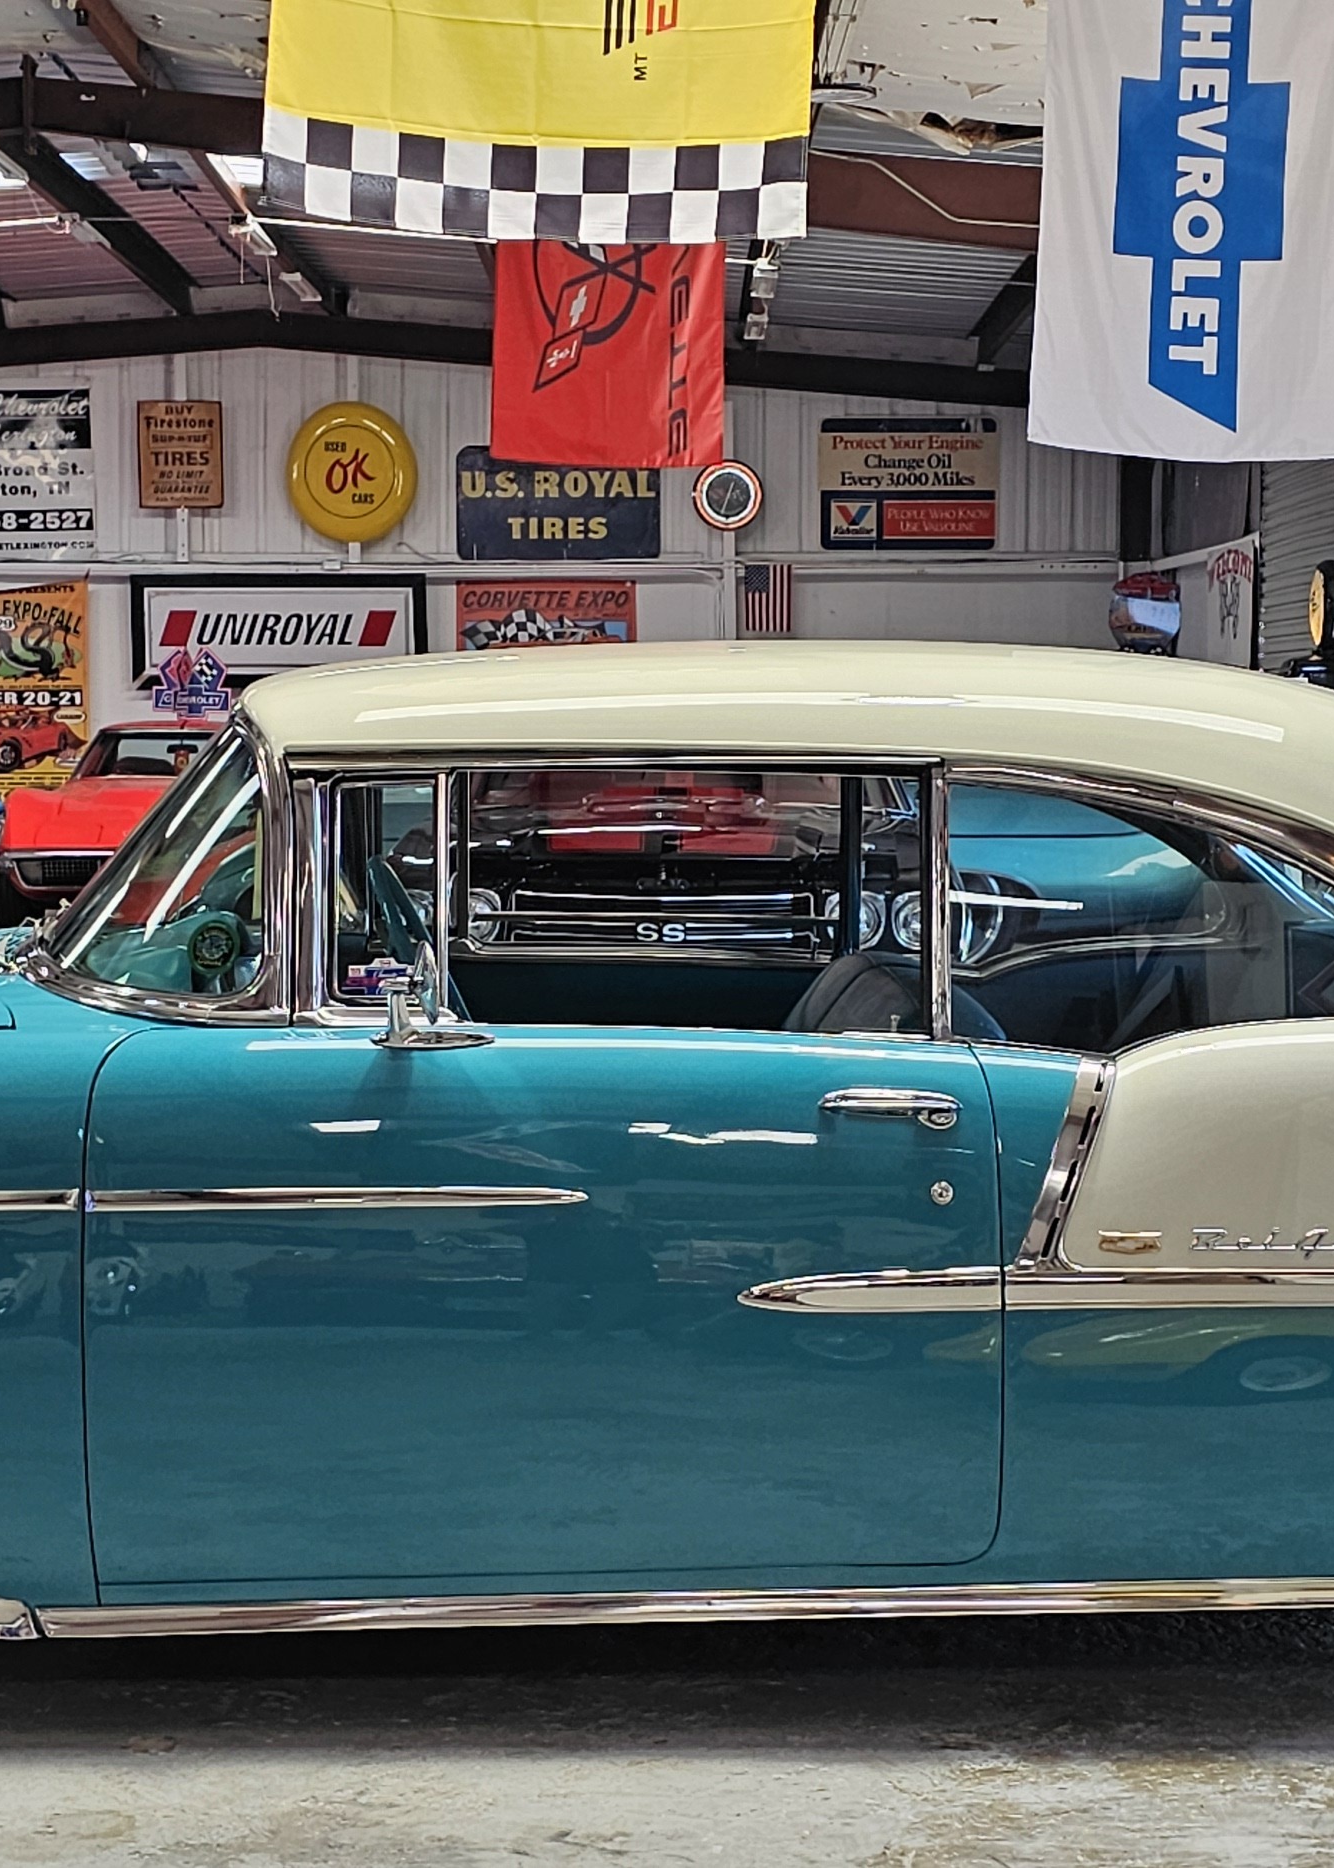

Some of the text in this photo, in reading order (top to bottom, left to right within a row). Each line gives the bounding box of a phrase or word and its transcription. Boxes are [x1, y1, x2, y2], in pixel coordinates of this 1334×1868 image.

[1168, 0, 1233, 376] HEVROLET
[164, 404, 195, 416] BUY
[144, 415, 214, 430] Firestone
[324, 440, 347, 453] USED
[831, 435, 984, 453] Protect Your Engine
[150, 450, 210, 467] TIRES
[864, 453, 952, 471] Change Oil
[57, 461, 85, 476] St.
[159, 470, 205, 479] NO LIMIT
[325, 447, 376, 495] OK
[47, 480, 70, 495] TN
[461, 469, 657, 499] U.S. ROYAL
[840, 471, 976, 488] Every 3,000 Miles
[153, 485, 211, 495] GUARANTEE
[351, 492, 375, 505] CARS
[507, 516, 608, 540] TIRES
[462, 589, 630, 609] CORVETTE EXPO
[196, 611, 354, 647] UNIROYAL
[22, 690, 82, 706] 20-21
[636, 922, 685, 942] SS
